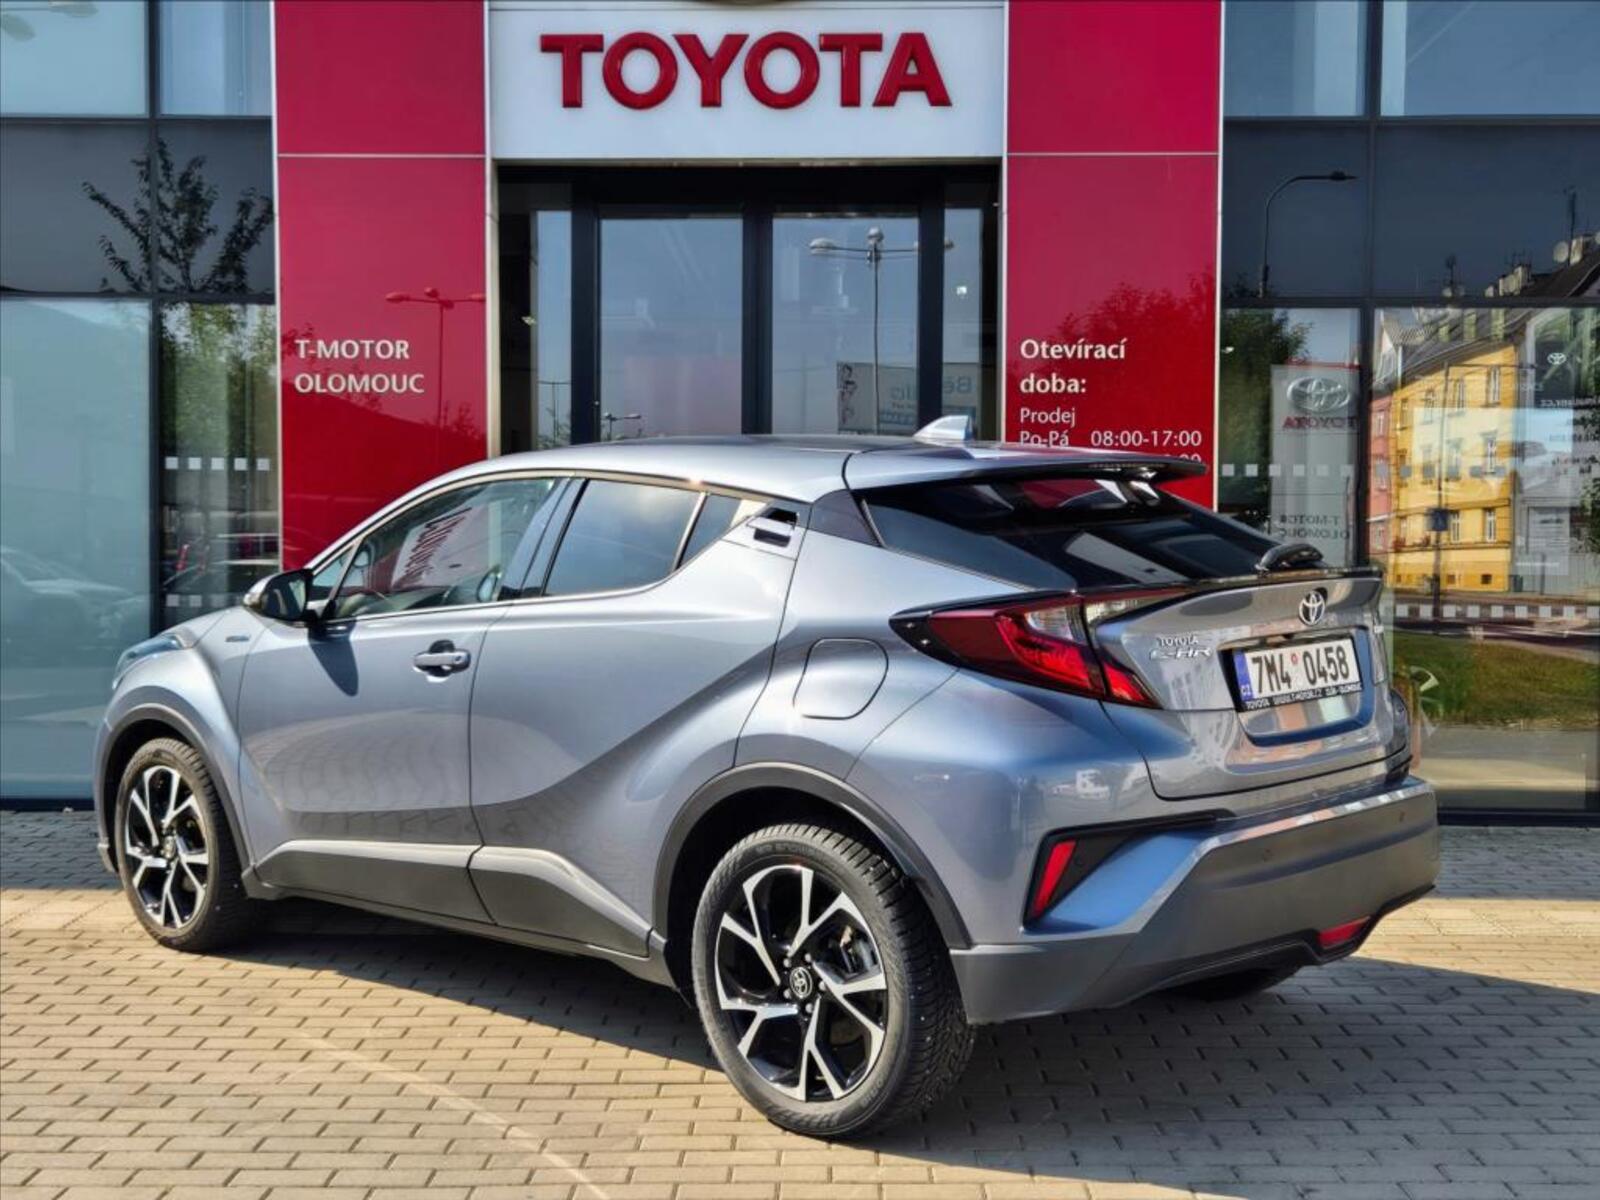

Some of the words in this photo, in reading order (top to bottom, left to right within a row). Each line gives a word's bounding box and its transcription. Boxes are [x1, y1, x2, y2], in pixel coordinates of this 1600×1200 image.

[540, 31, 953, 110] TOYOTA
[294, 339, 410, 359] T-MOTOR
[1020, 337, 1128, 359] Otevírací
[294, 373, 425, 393] OLOMOUC
[1019, 372, 1087, 394] doba:
[1020, 407, 1076, 428] Prodej
[1020, 430, 1069, 447] Po-Pá
[1091, 430, 1202, 447] 08:00-17:00
[1156, 634, 1199, 647] TOYOTA
[1251, 652, 1292, 694] 7M4
[1303, 646, 1350, 685] 0458
